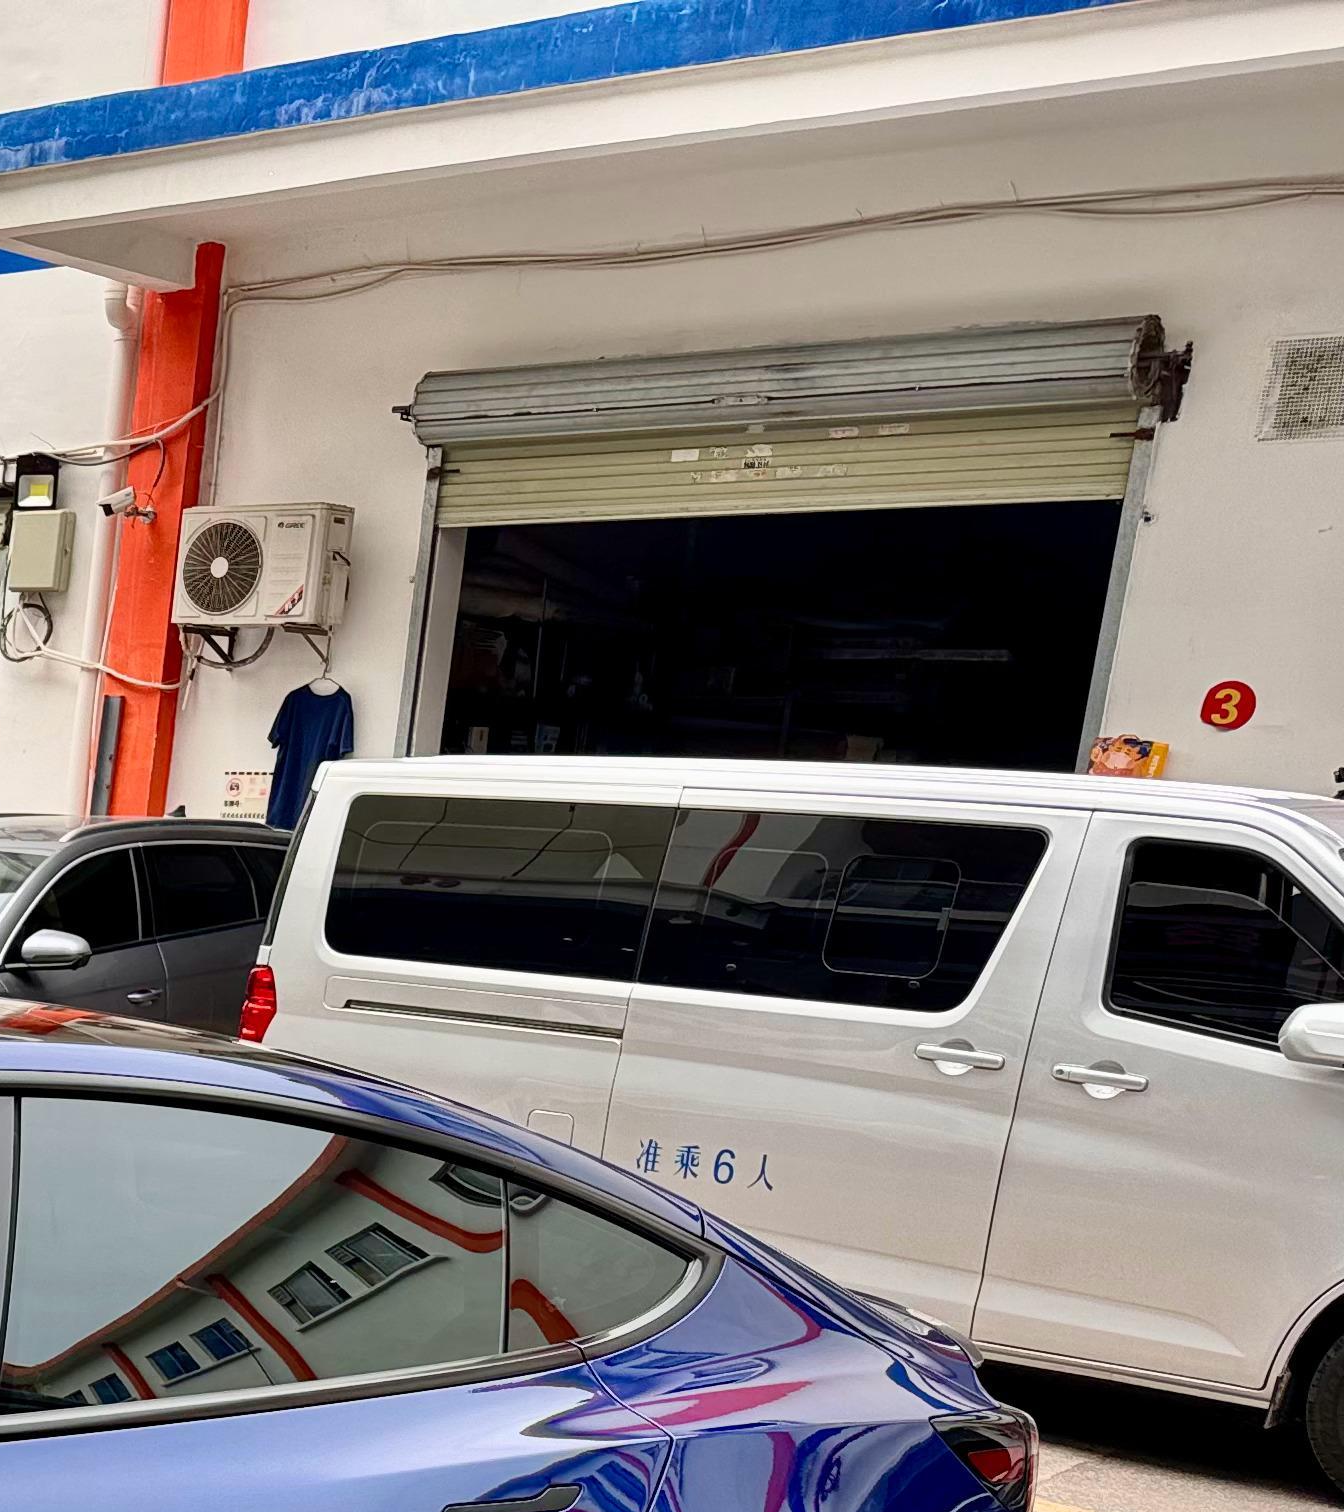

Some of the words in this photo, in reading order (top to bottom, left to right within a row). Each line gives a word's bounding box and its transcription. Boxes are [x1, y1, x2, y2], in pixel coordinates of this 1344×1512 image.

[1210, 688, 1241, 725] 3
[636, 1138, 774, 1191] 准乘6人
